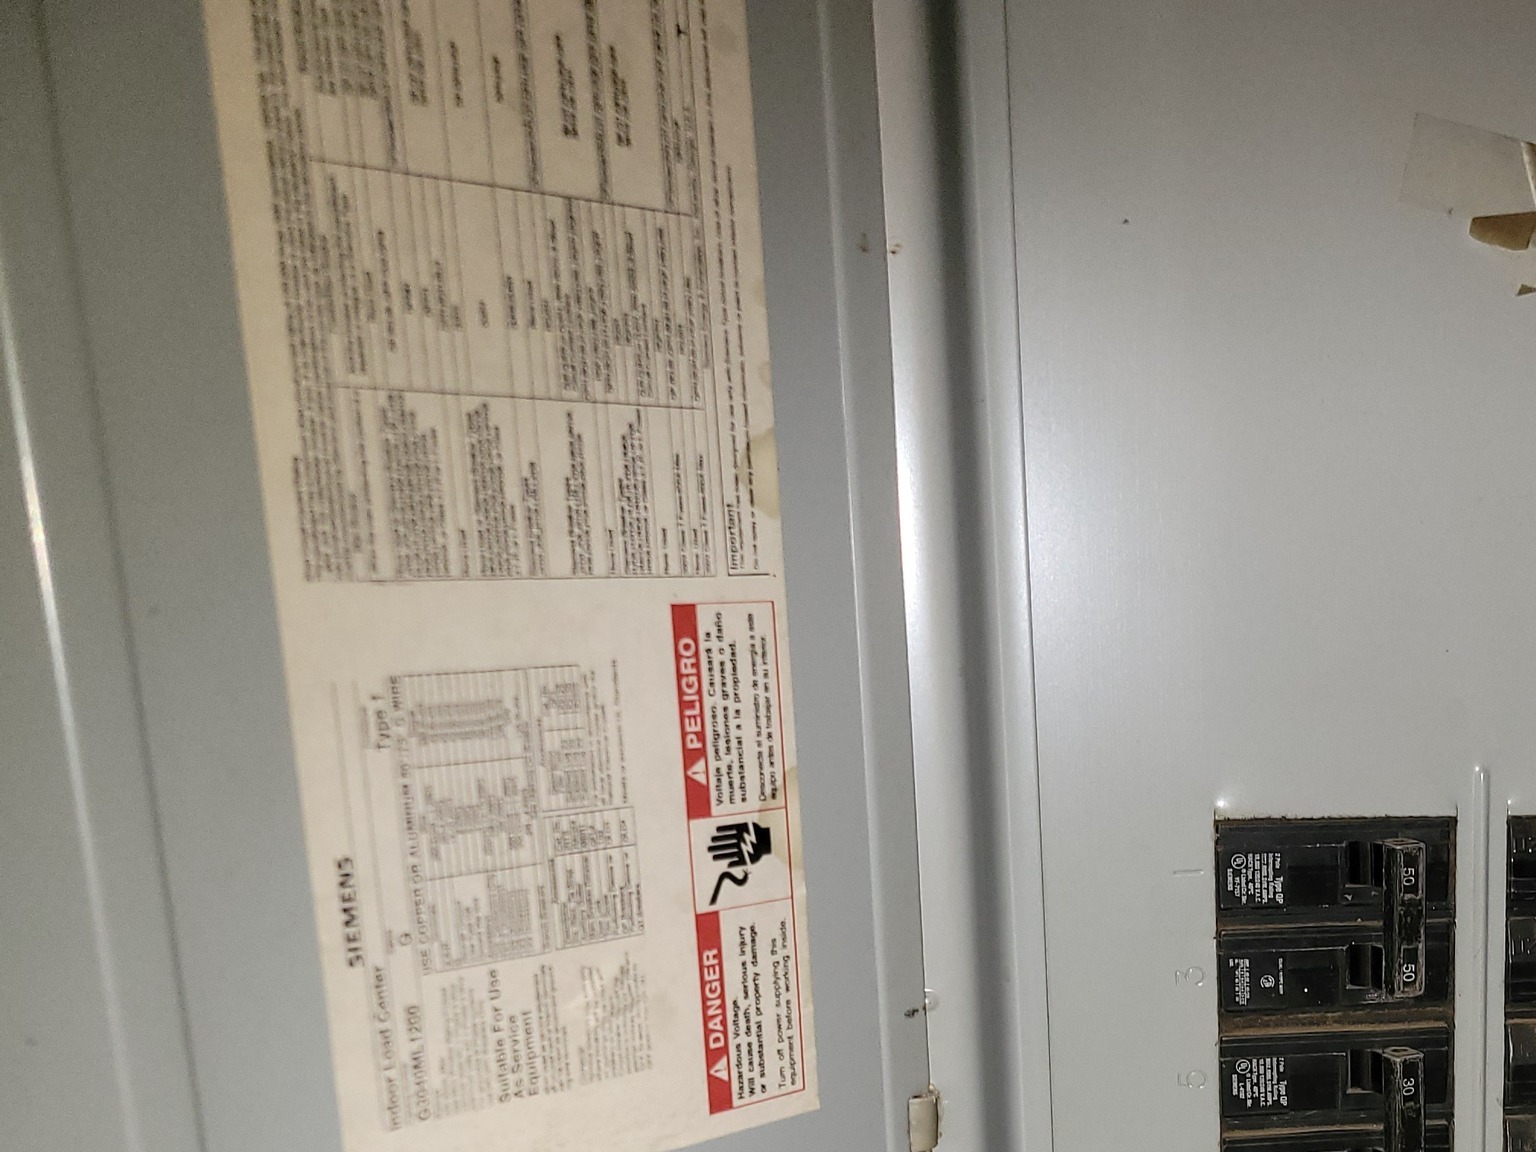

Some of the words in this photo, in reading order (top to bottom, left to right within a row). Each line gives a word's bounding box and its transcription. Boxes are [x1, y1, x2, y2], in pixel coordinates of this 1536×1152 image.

[713, 612, 724, 642] daño
[704, 647, 716, 697] Causará
[718, 660, 729, 700] graves
[728, 639, 741, 703] propiedad.
[677, 636, 703, 749] PELIGRO
[372, 708, 391, 750] Type
[708, 701, 721, 761] peligroso.
[721, 706, 732, 755] lesiones
[713, 766, 725, 806] Voltaje
[725, 759, 736, 804] muerte,
[735, 736, 747, 803] substancial
[1274, 876, 1283, 892] Type
[1403, 867, 1415, 886] 50
[335, 856, 365, 969] SIEMENS
[736, 925, 747, 956] injury
[747, 921, 759, 967] damage.
[768, 937, 777, 956] this
[778, 917, 788, 949] inside.
[486, 968, 501, 1001] Use
[739, 960, 749, 1000] serious
[770, 960, 782, 1008] supplying
[780, 954, 792, 993] working
[1175, 966, 1207, 987] 3
[1403, 963, 1415, 982] 50
[701, 947, 725, 1049] DANGER
[751, 971, 763, 1016] property
[489, 1004, 505, 1033] For
[730, 996, 741, 1039] Voltage.
[742, 1003, 753, 1037] death,
[775, 1012, 784, 1043] power
[783, 998, 793, 1030] before
[505, 1014, 522, 1074] Service
[519, 1008, 542, 1096] Equipment
[746, 1041, 754, 1072] cause
[754, 1020, 766, 1078] substantial
[786, 1034, 798, 1086] equipment
[493, 1037, 512, 1103] Suitable
[512, 1077, 525, 1099] As
[733, 1042, 745, 1100] Hazardous
[747, 1076, 756, 1097] Will
[777, 1065, 786, 1089] Turn
[1177, 1069, 1208, 1090] 5
[1278, 1080, 1287, 1095] Type
[1403, 1077, 1415, 1096] 30
